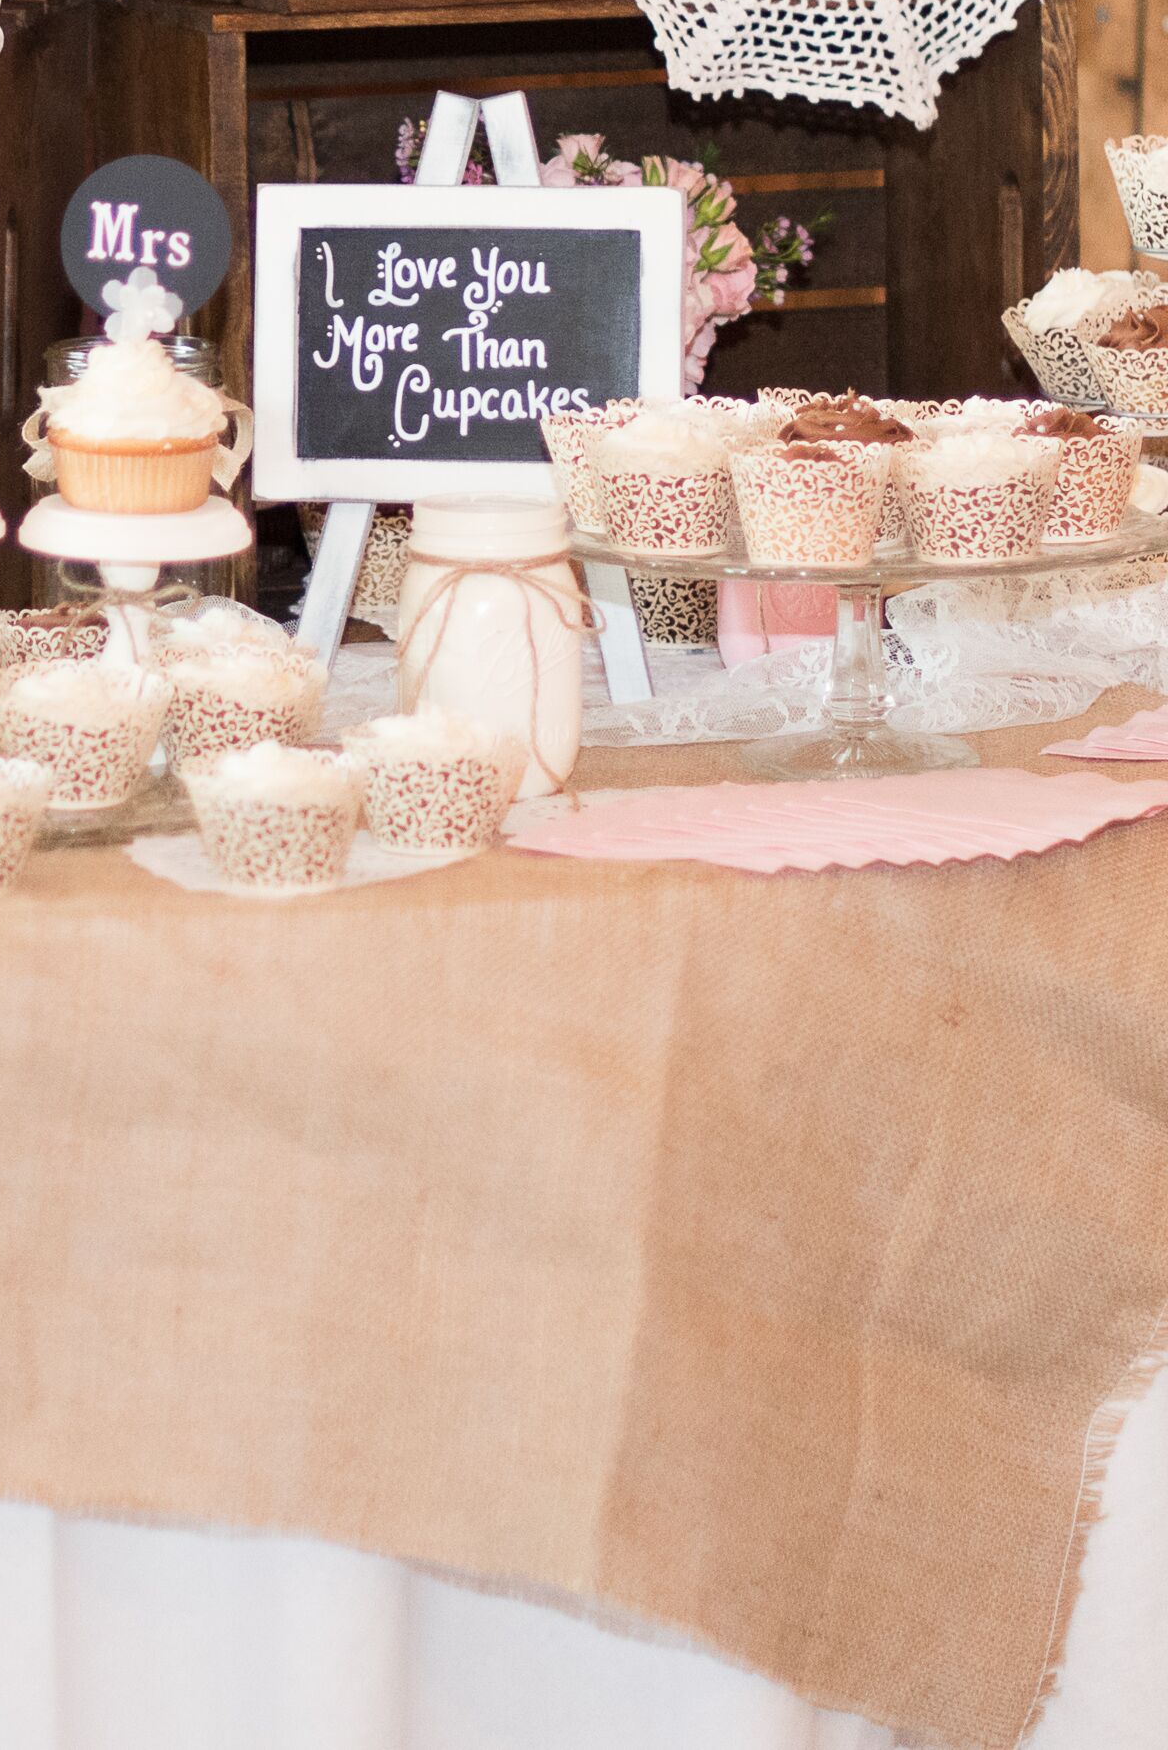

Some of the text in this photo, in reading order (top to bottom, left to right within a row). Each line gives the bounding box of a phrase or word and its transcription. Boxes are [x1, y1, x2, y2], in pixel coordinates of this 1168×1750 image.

[86, 200, 192, 268] Mrs
[315, 240, 551, 313] I Love You
[313, 310, 548, 392] More Than
[392, 363, 591, 443] Cupcakes
